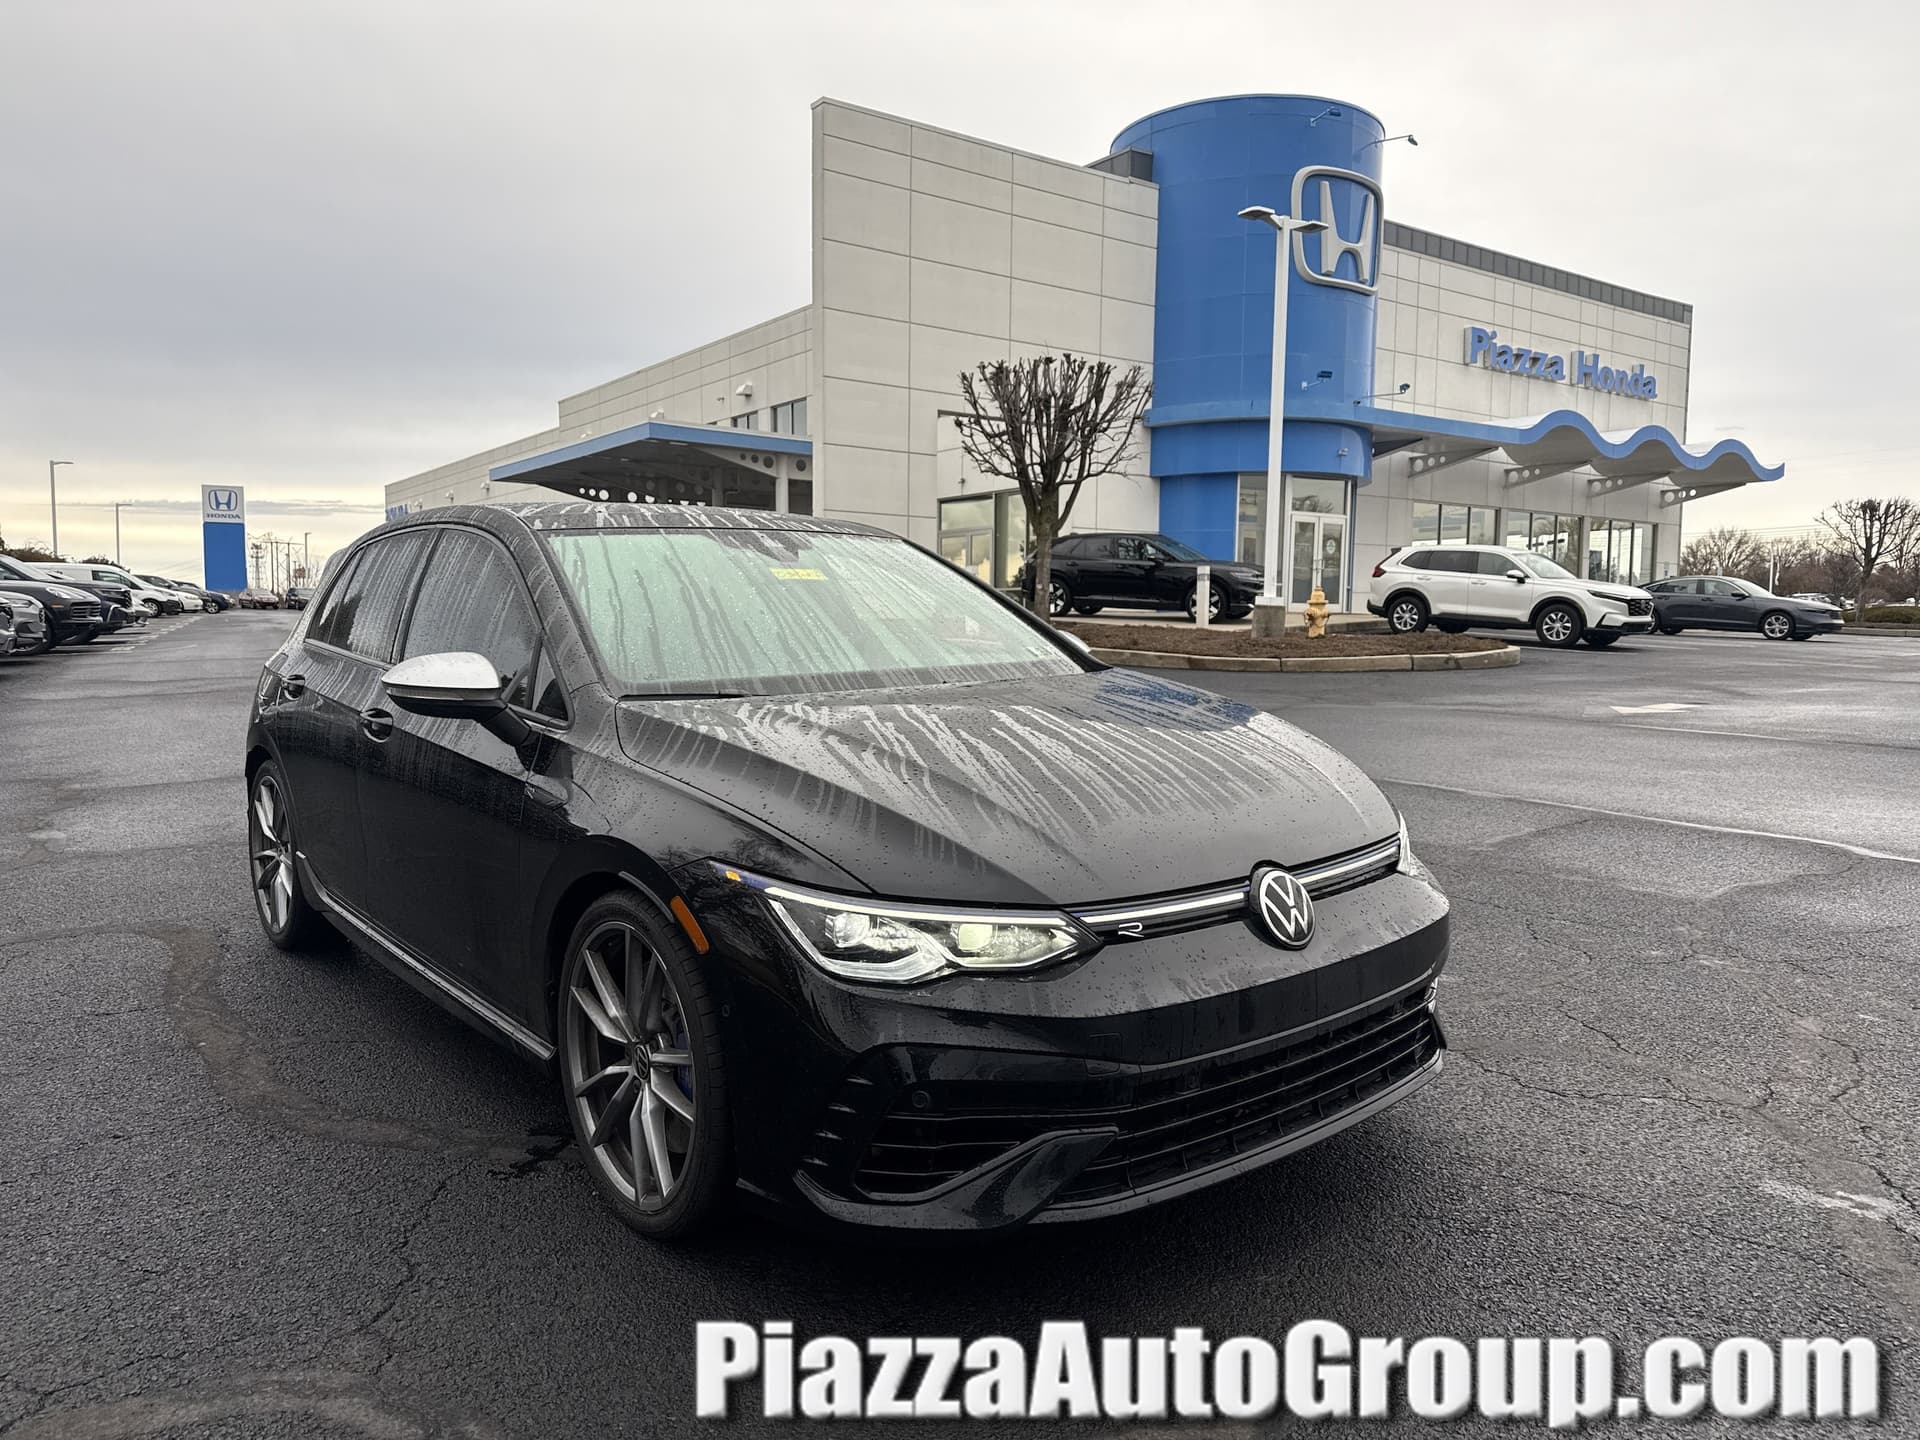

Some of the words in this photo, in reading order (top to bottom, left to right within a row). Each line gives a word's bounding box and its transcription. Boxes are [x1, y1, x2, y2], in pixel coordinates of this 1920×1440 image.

[1464, 326, 1566, 382] Piazza
[1571, 350, 1658, 401] Honda
[207, 512, 241, 520] HONDA
